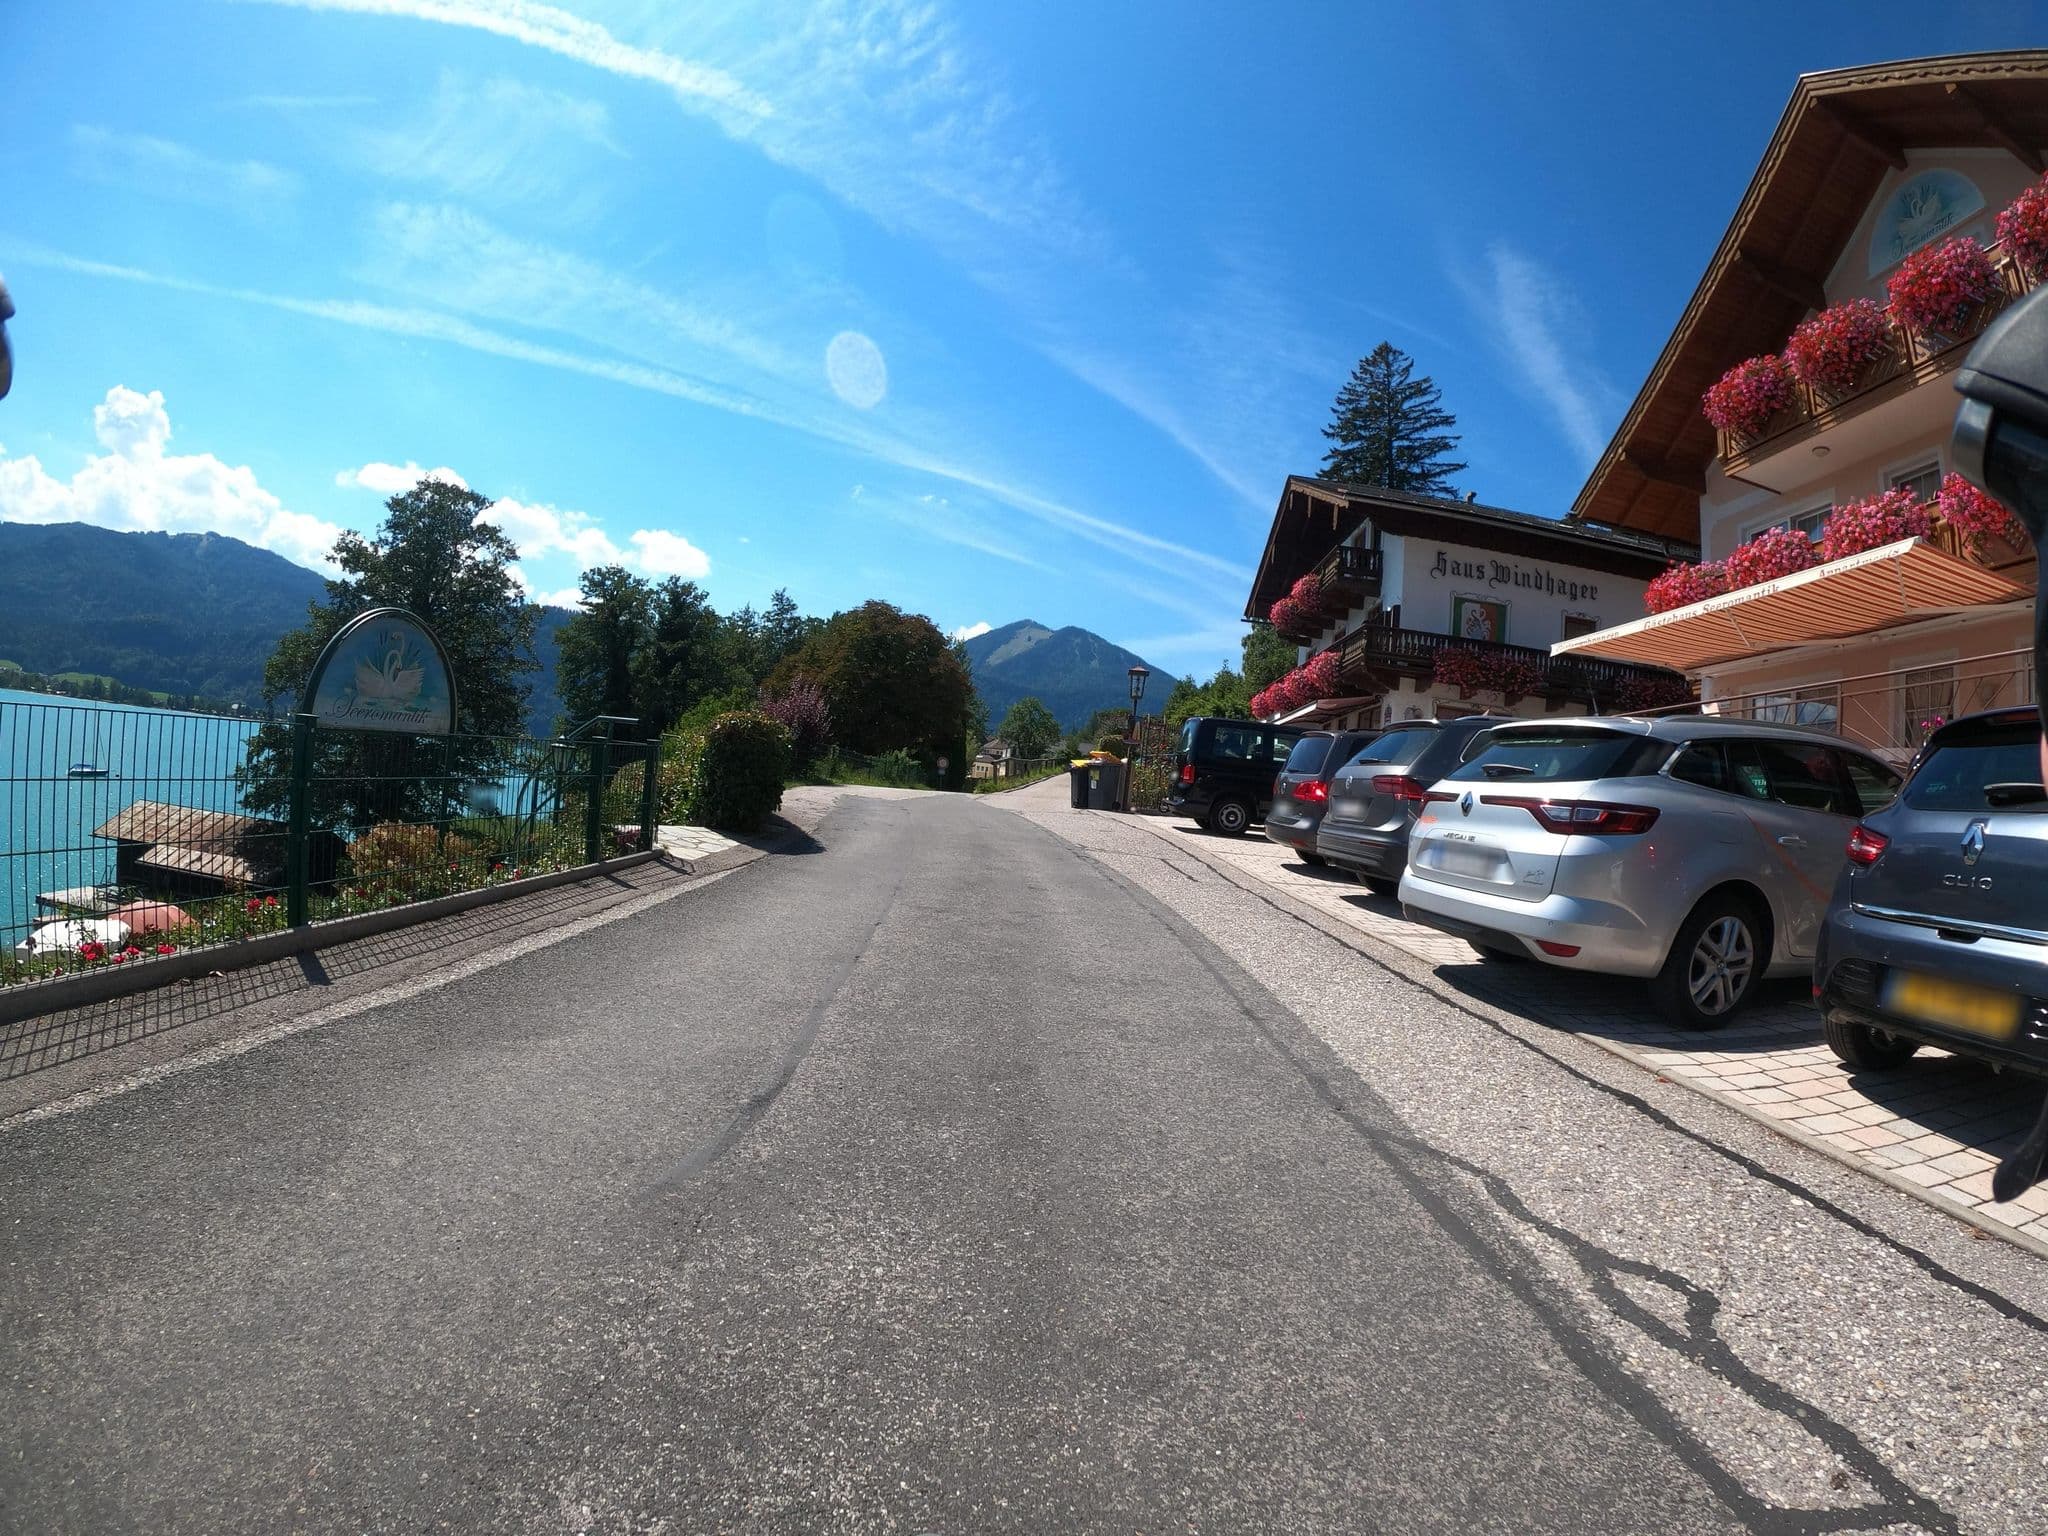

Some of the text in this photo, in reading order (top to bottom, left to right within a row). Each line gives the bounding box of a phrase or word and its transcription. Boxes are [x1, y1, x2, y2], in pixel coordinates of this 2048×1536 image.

[1430, 550, 1599, 601] Haus Windhager
[1702, 584, 1780, 614] Seeromantik
[327, 690, 431, 724] Seeromantik
[1942, 873, 1993, 891] CLIO
